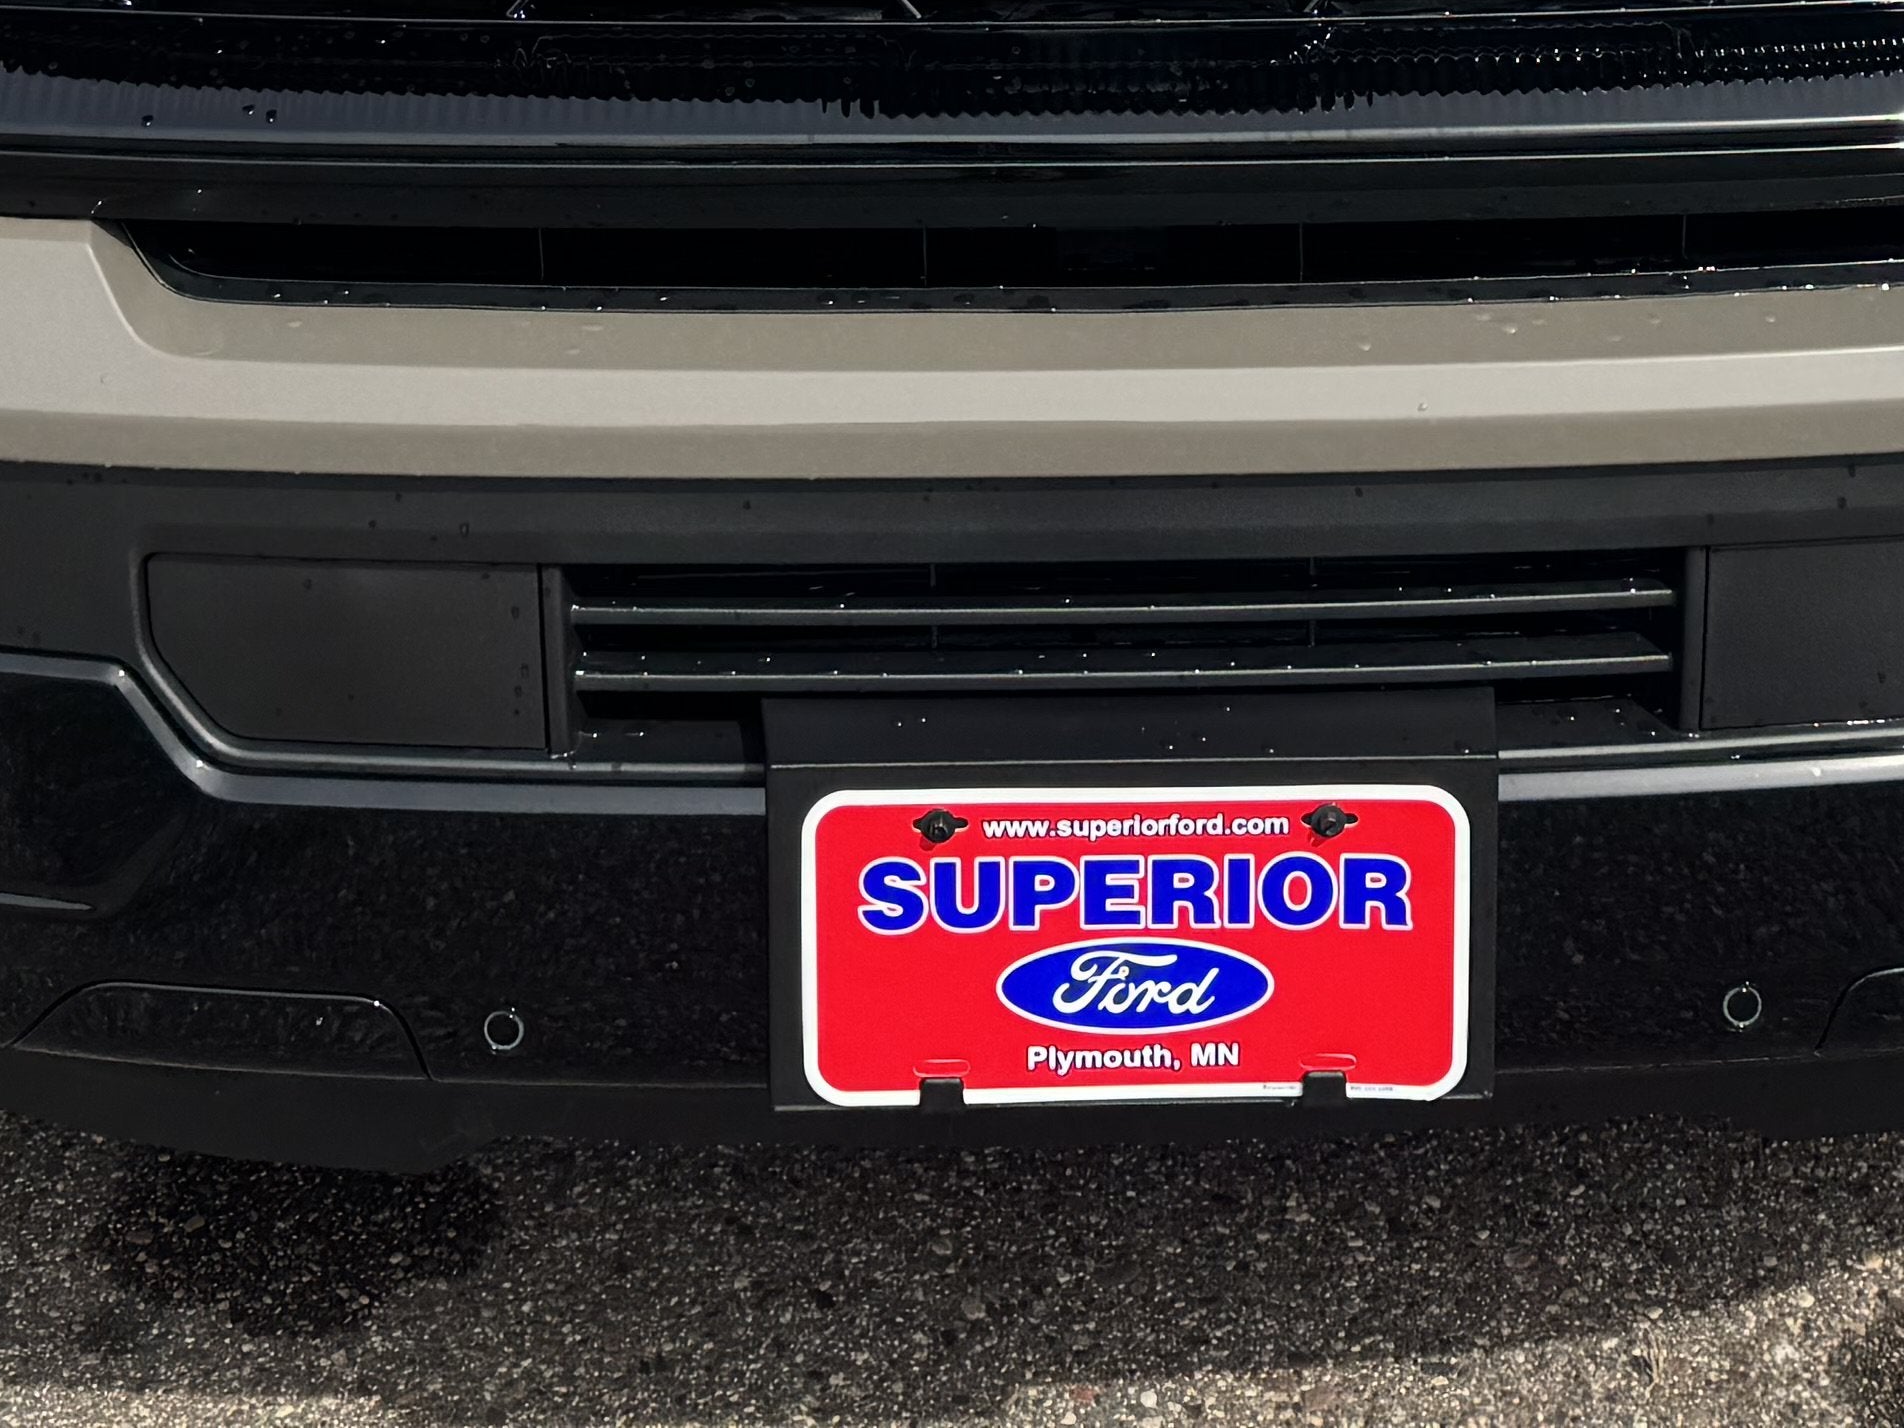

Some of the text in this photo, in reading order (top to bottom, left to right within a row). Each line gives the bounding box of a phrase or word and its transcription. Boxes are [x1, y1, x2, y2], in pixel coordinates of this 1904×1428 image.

[982, 811, 1289, 840] www.superiorford.com
[858, 852, 1414, 936] SUPERIOR
[1052, 951, 1216, 1015] Ford
[1026, 1043, 1241, 1075] Plymouth, MN
